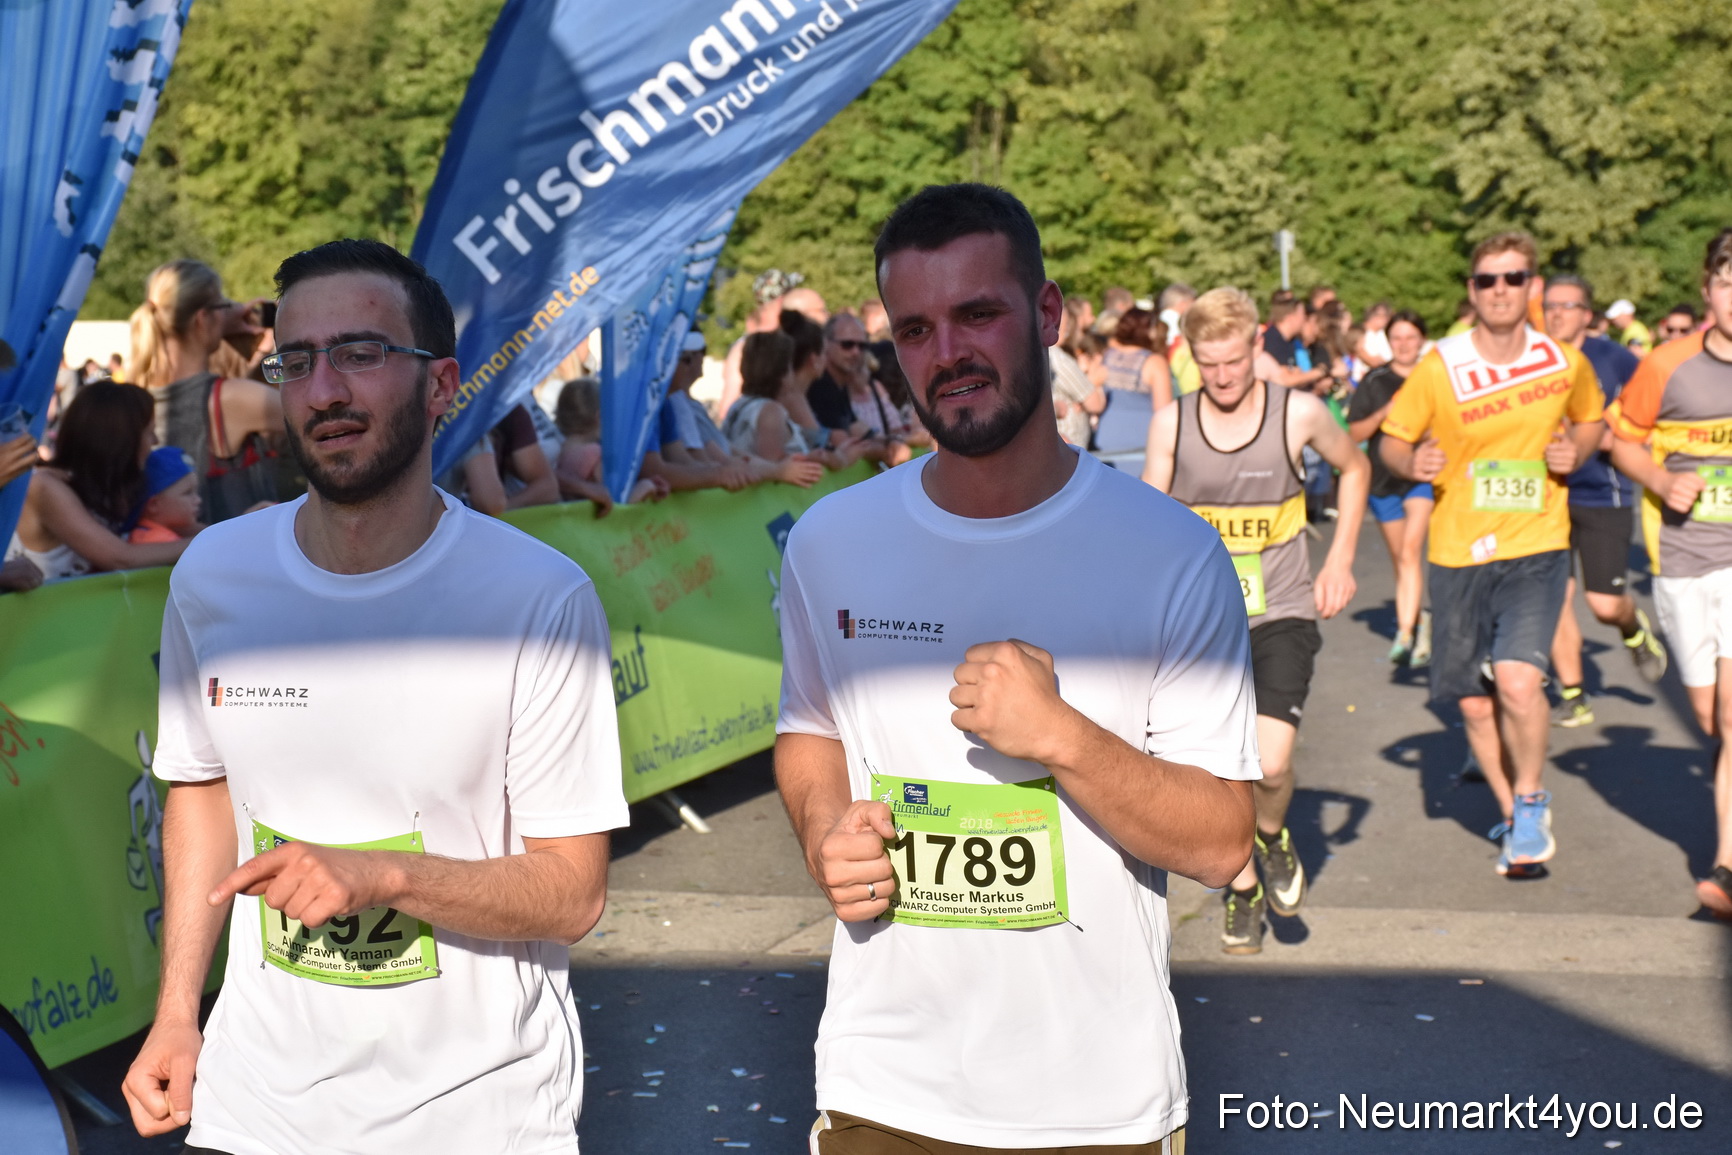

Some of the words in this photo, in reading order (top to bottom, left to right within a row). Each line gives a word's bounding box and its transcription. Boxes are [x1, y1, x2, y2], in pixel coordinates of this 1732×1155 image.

[692, 57, 785, 138] Druck
[781, 0, 844, 62] und
[452, 0, 812, 285] Frischman
[1460, 396, 1512, 425] MAX
[1483, 478, 1536, 498] 1336
[858, 619, 944, 634] SCHWARZ
[902, 635, 943, 643] SYSTEME
[225, 687, 309, 698] SCHWARZ
[893, 800, 952, 817] firmenlauf
[960, 817, 993, 829] 2018
[894, 831, 1036, 888] 1789
[910, 886, 965, 903] Krauser
[969, 890, 1025, 903] Markus
[889, 900, 930, 912] CHWARZ
[931, 903, 977, 915] Computer
[980, 906, 1022, 916] Systeme
[1025, 900, 1056, 913] GmbH
[282, 935, 336, 959] Almarawi
[339, 948, 393, 960] Yaman
[267, 941, 299, 962] SCHWARZ
[300, 955, 341, 970] Computer
[344, 962, 388, 973] Systeme
[390, 956, 422, 968] GmbH
